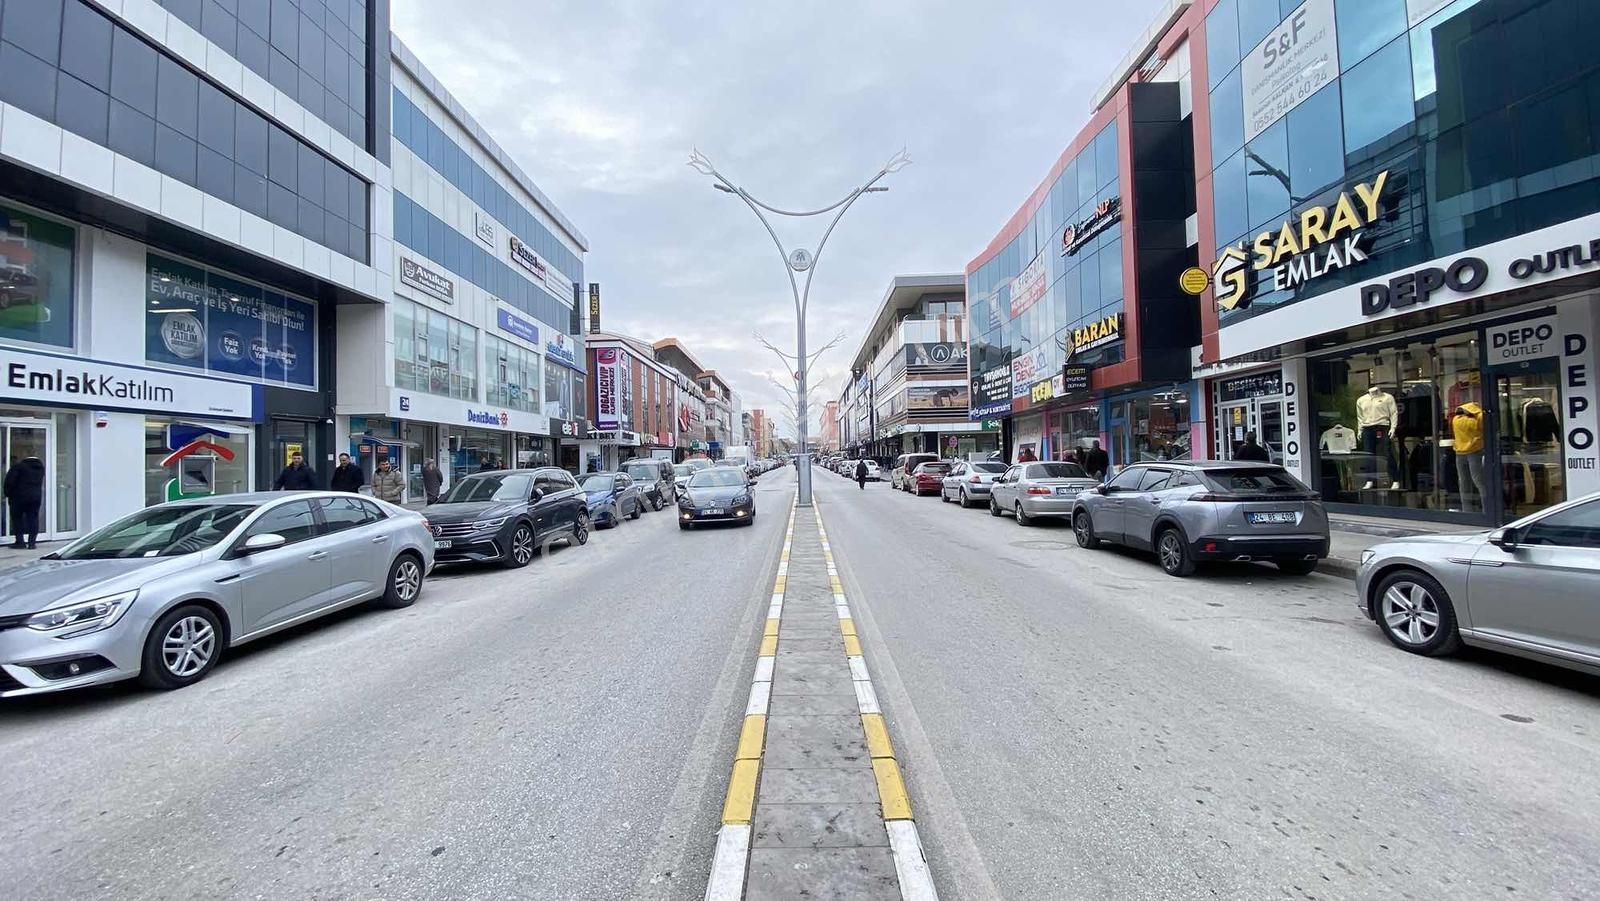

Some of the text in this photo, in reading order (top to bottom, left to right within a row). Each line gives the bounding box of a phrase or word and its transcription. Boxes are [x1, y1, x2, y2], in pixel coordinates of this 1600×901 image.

[1263, 8, 1306, 69] S&F
[1298, 80, 1311, 98] 60
[1313, 70, 1328, 88] 24
[1253, 170, 1389, 271] SARAY
[1273, 232, 1370, 292] EMLAK
[416, 266, 450, 290] Avukat
[1360, 256, 1489, 317] DEPO
[151, 280, 170, 296] Ev,
[173, 287, 200, 305] Araç
[203, 296, 216, 307] ve
[231, 301, 249, 317] Yeri
[170, 330, 198, 342] KATILIM
[172, 320, 196, 333] EMLAK
[1074, 312, 1118, 347] BARAN
[1493, 324, 1553, 348] DEPO
[223, 336, 239, 348] Faiz
[224, 343, 239, 355] Yok
[1502, 343, 1545, 358] OUTLET
[1032, 379, 1052, 403] ECEM
[1564, 333, 1595, 450] DEPO
[468, 409, 500, 426] DenizBank
[1285, 382, 1299, 456] DEPO
[1568, 457, 1596, 469] OUTLET
